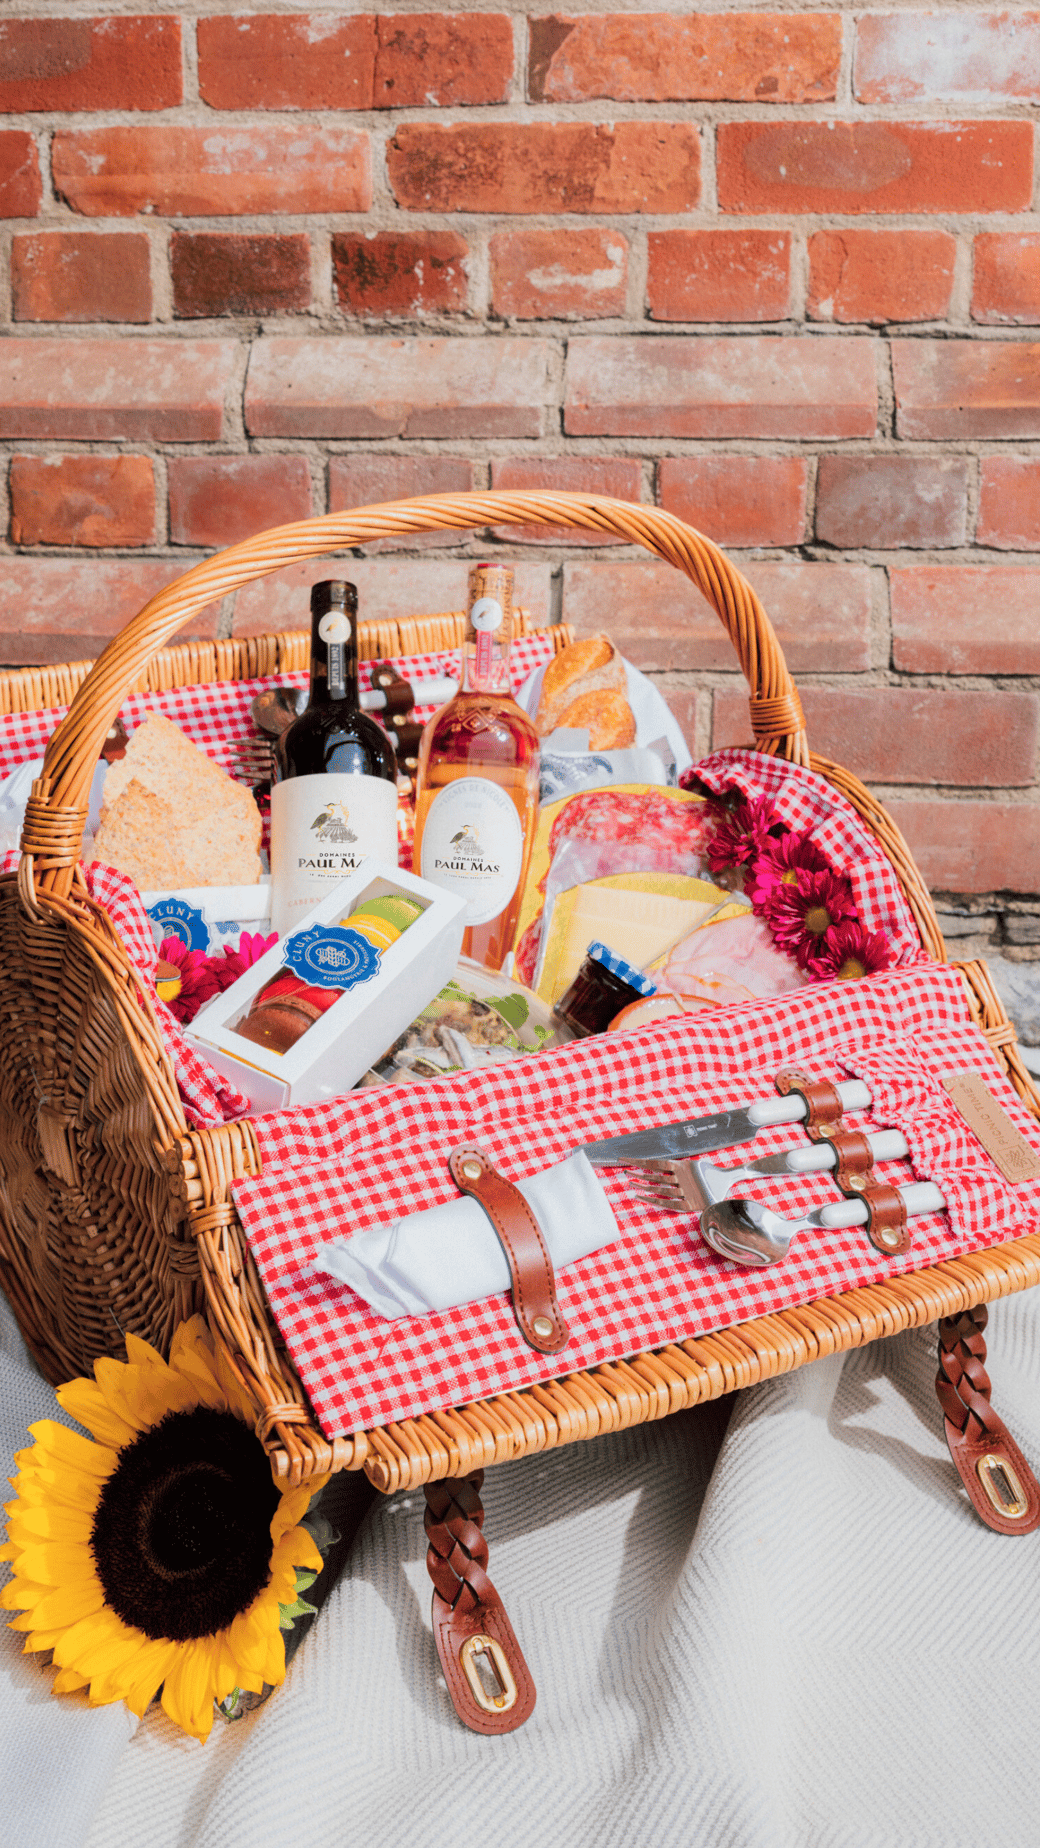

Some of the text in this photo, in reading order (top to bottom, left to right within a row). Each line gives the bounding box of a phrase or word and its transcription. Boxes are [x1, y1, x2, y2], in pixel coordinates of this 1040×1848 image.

[298, 858, 336, 868] PAUL
[434, 859, 501, 873] PAUL MAS
[292, 930, 320, 962] CLUNY
[981, 1113, 1009, 1146] PICNIC
